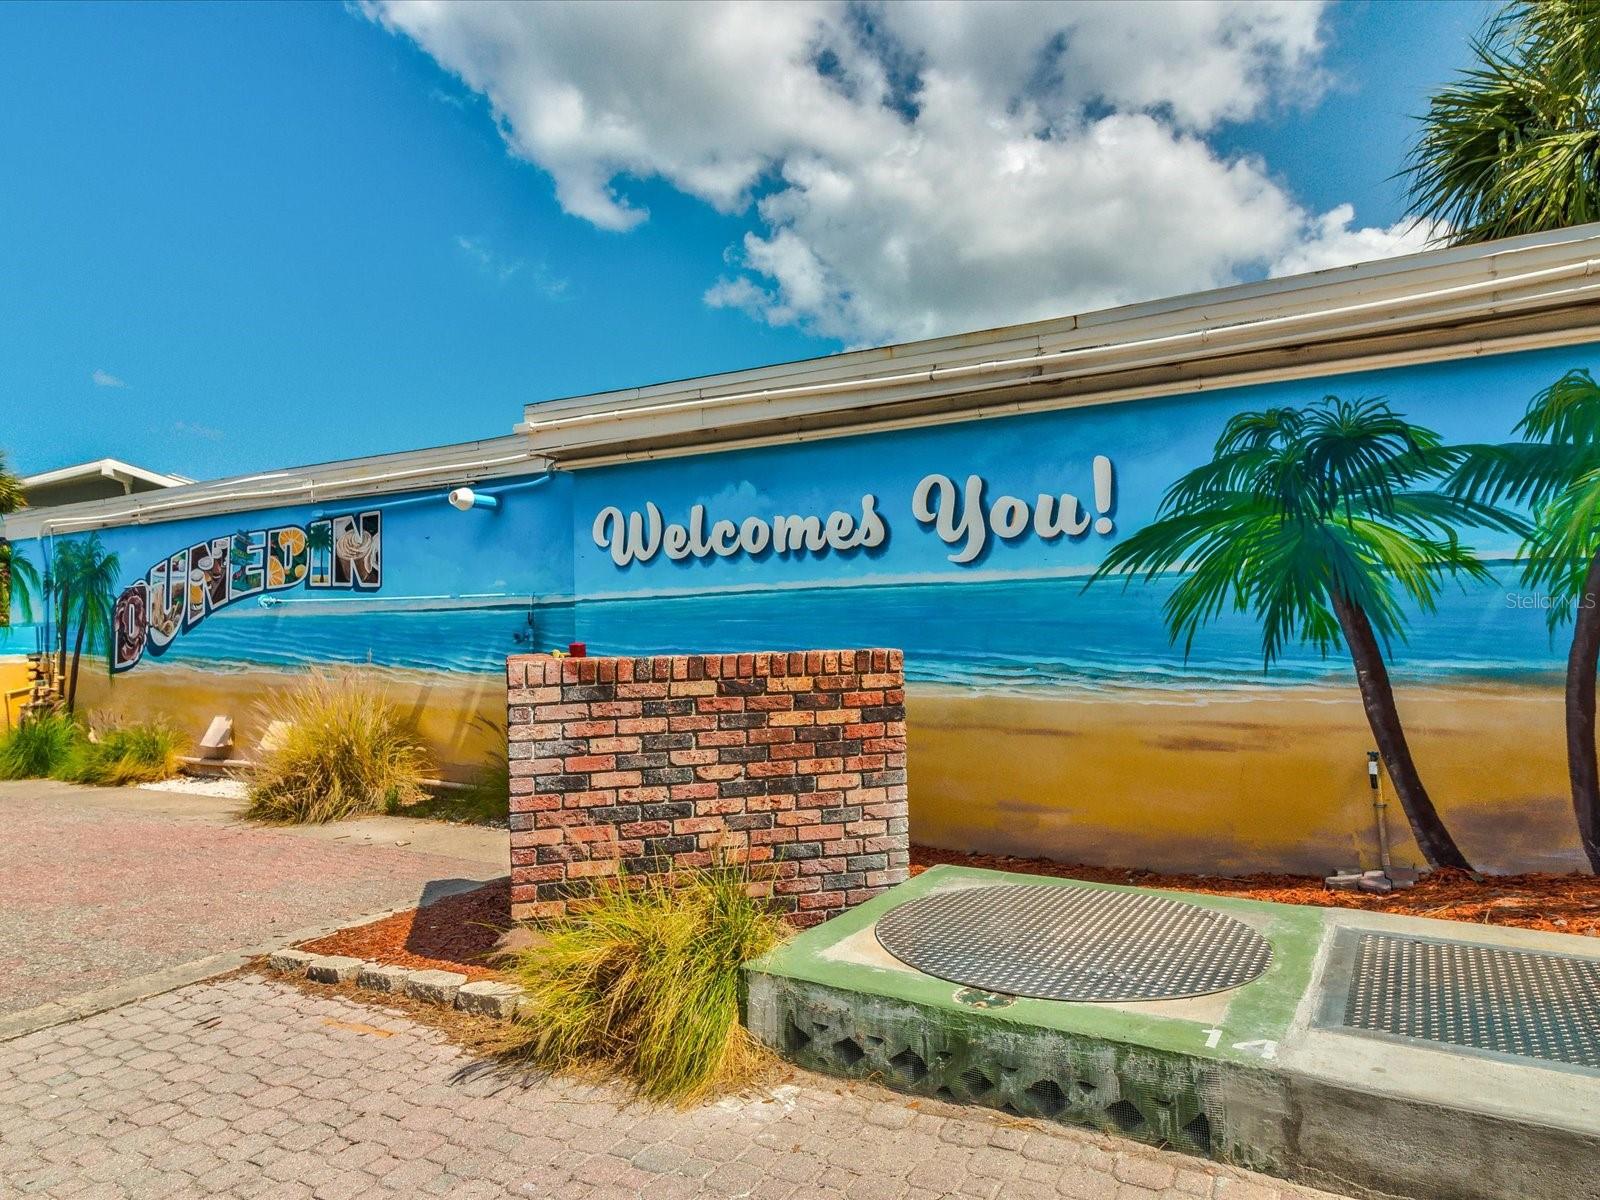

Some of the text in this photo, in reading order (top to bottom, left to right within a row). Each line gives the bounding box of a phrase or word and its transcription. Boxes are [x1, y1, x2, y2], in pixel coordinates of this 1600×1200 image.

[592, 454, 1114, 567] Welcomes You!
[113, 510, 383, 669] DUNEDIN
[1201, 1029, 1278, 1060] 14
